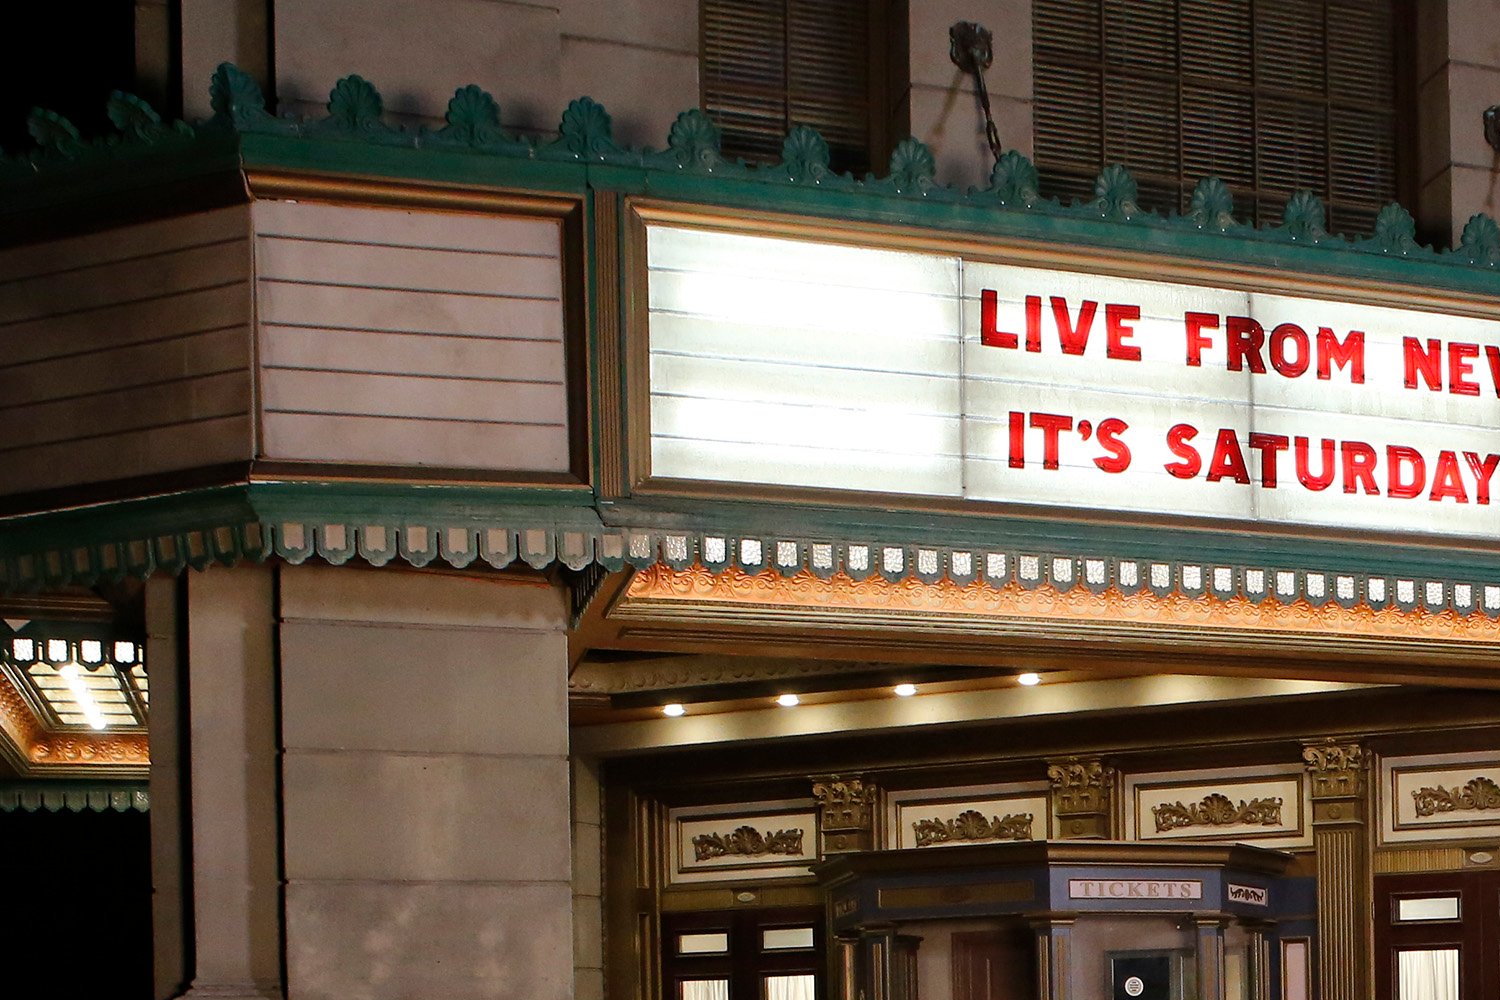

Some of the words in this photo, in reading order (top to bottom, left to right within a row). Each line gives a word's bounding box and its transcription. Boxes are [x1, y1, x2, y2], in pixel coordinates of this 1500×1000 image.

[980, 288, 1143, 362] LIVE
[1184, 312, 1366, 384] FROM
[1008, 411, 1133, 475] IT'S
[1081, 882, 1192, 898] TICKETS
